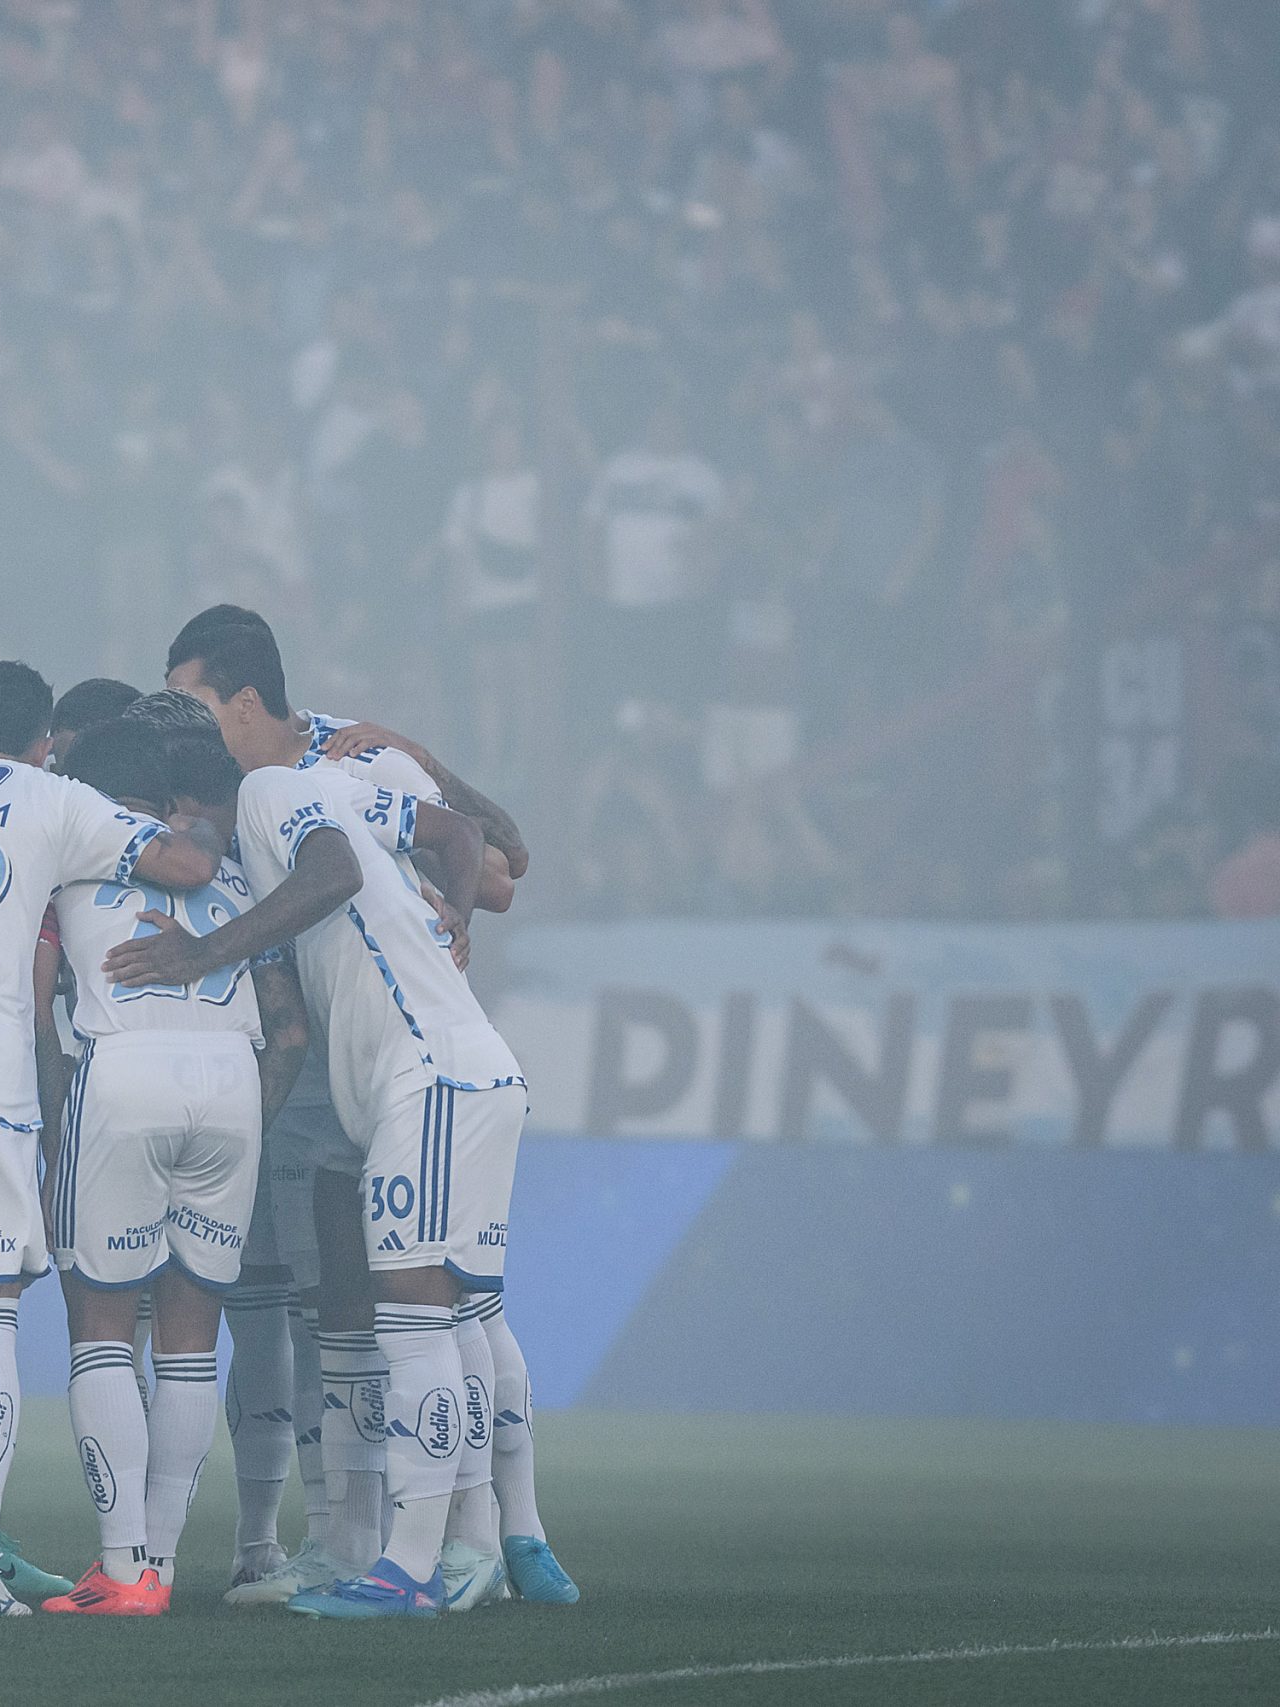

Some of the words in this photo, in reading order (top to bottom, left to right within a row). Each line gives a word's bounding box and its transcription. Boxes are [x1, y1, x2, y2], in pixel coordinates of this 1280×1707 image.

[216, 866, 248, 897] RO
[181, 1206, 238, 1233] FACULDADE
[371, 1175, 415, 1221] 30
[477, 1231, 507, 1247] MUL
[429, 1393, 450, 1450] Kodilar
[467, 1382, 486, 1440] Kodilar
[84, 1441, 109, 1504] Kodilar
